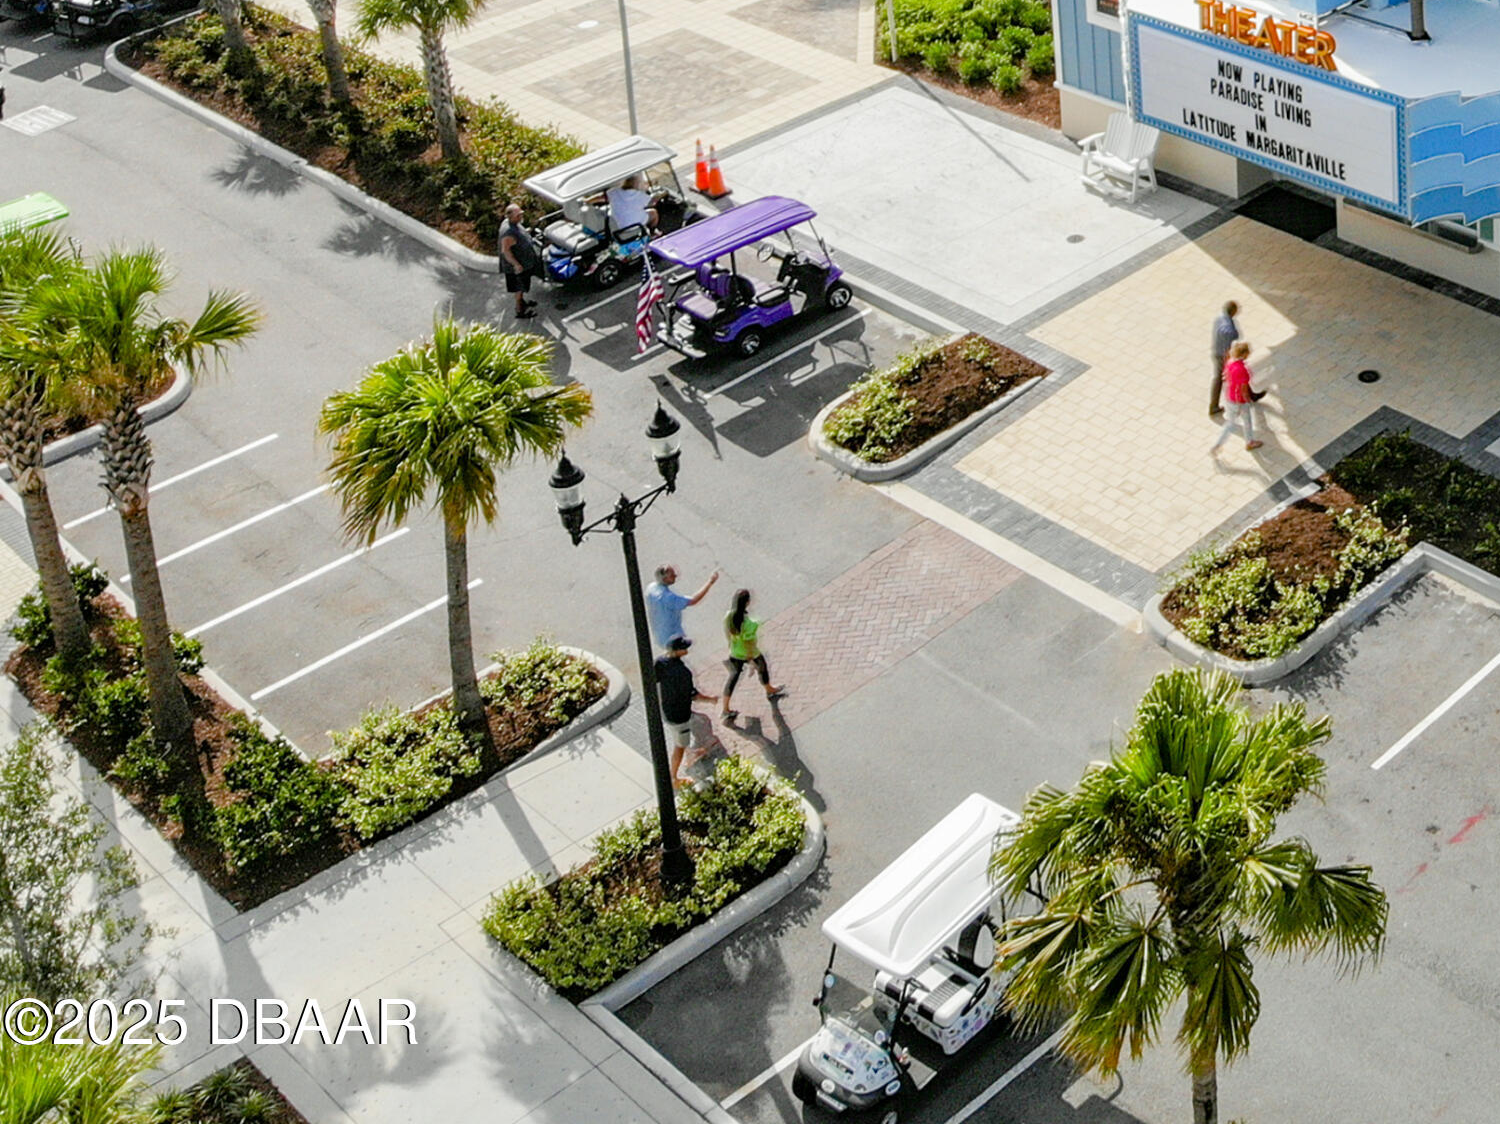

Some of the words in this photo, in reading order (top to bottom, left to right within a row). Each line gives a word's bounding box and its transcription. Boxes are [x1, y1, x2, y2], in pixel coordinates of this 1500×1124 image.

[1210, 78, 1264, 112] PARADISE
[1275, 99, 1312, 127] LIVING
[1218, 59, 1242, 83] NOW
[1254, 72, 1303, 103] PLAYING
[1183, 107, 1237, 142] LATITUDE
[1246, 130, 1346, 180] MARGARITAVILLE
[1255, 114, 1267, 132] IN
